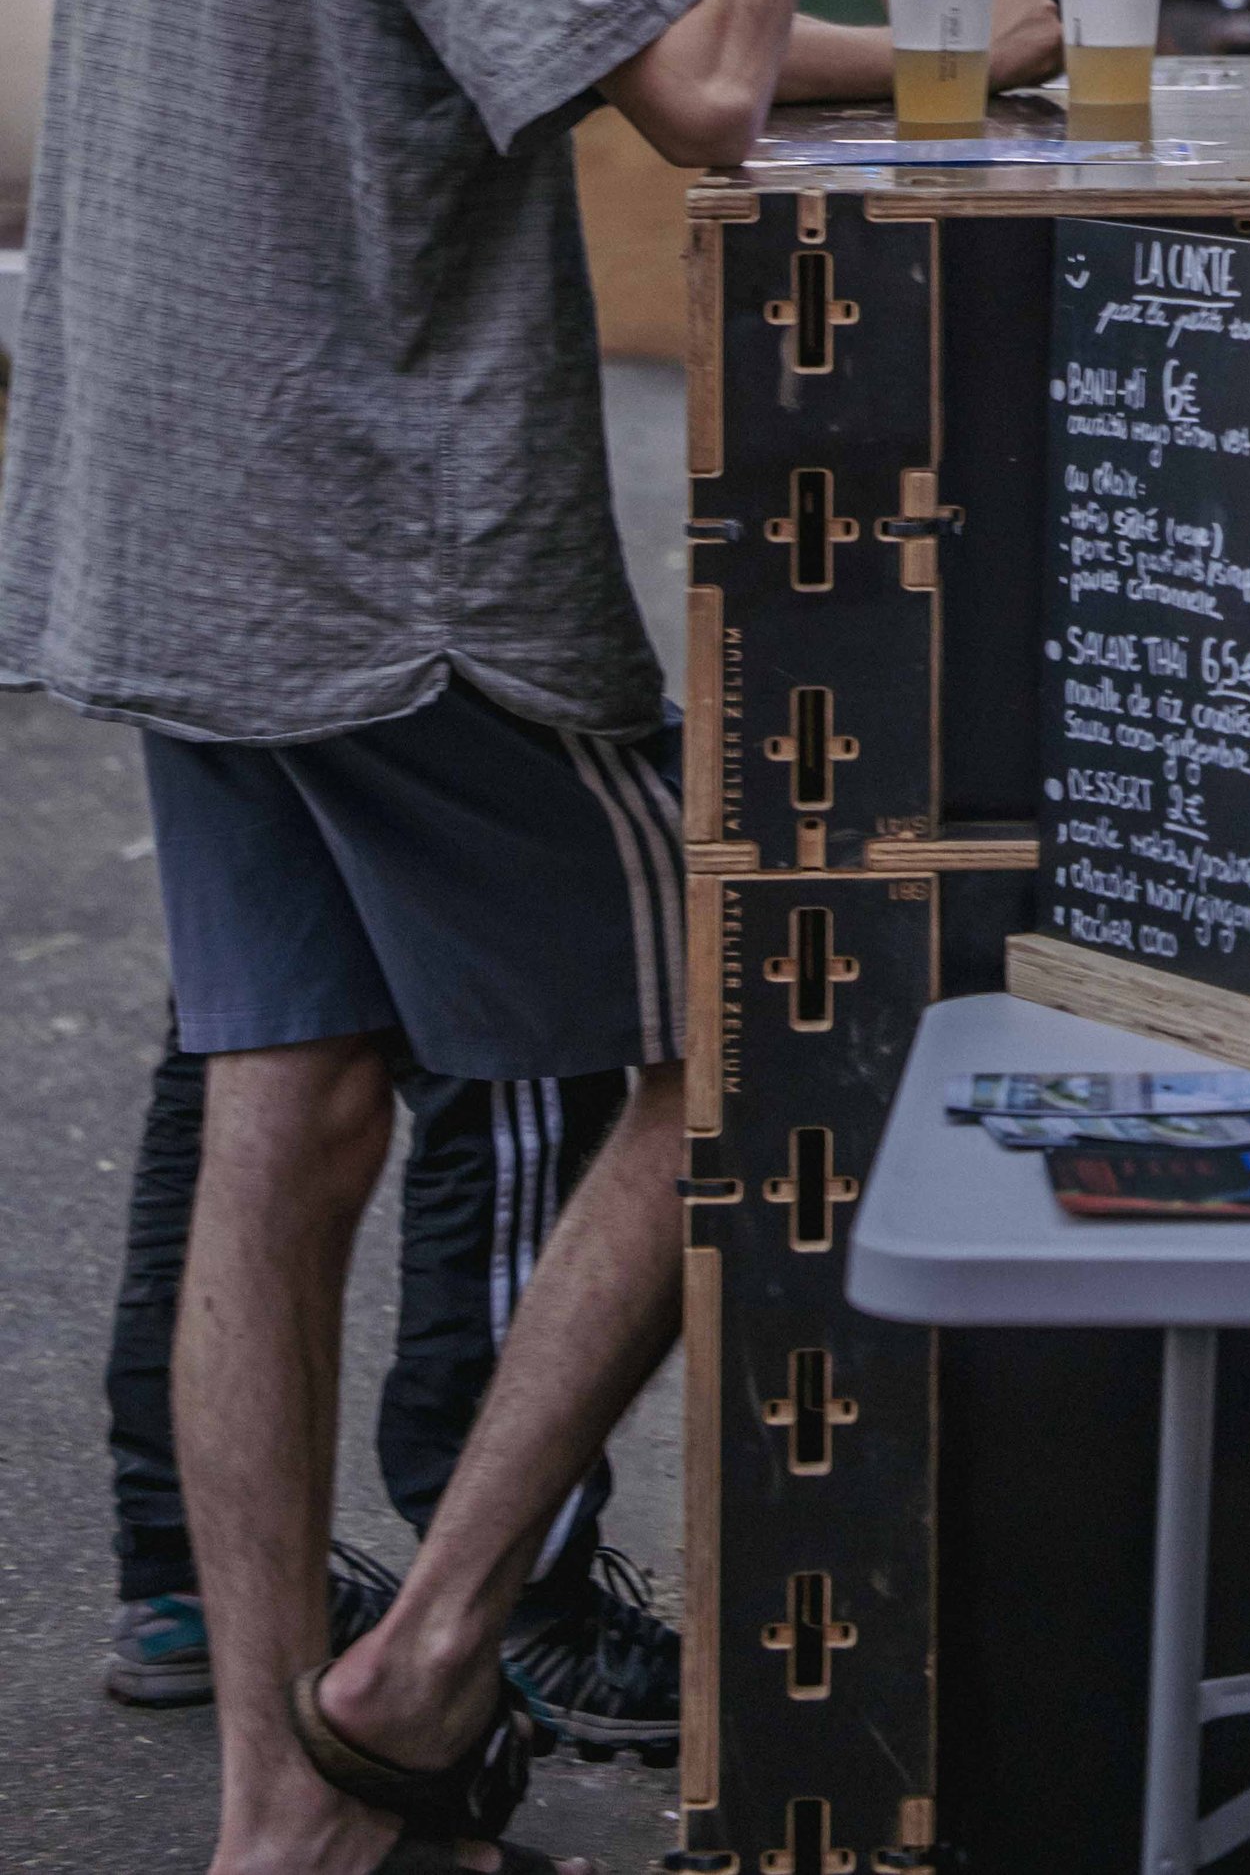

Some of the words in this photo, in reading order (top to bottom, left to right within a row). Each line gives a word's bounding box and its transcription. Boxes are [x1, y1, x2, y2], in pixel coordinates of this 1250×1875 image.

[1135, 241, 1165, 288] LA
[1168, 244, 1242, 297] CARTE
[1162, 358, 1201, 417] 6€
[1117, 539, 1134, 567] 5
[1067, 625, 1142, 672] SALADE
[1127, 683, 1152, 718] de
[724, 732, 743, 830] ATELIER
[1067, 768, 1154, 811] DESSERT
[1167, 784, 1207, 825] 2€
[724, 889, 743, 988] ATELIER
